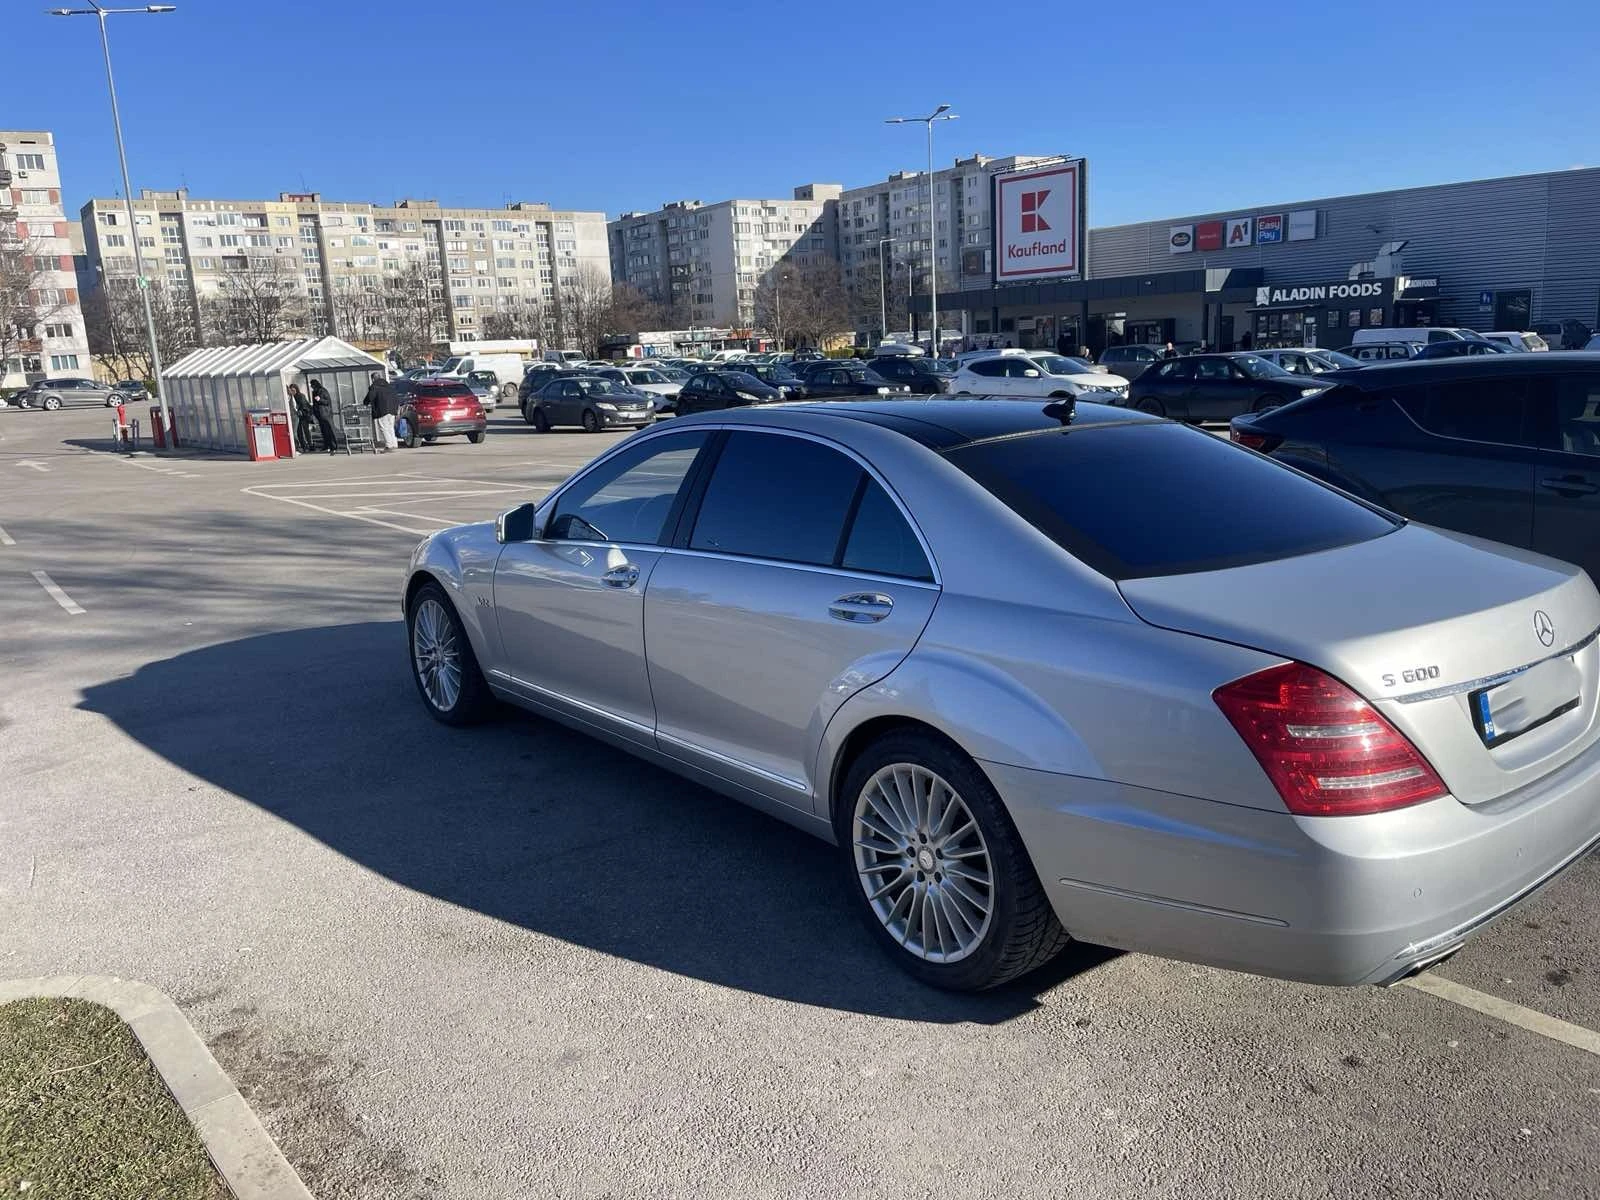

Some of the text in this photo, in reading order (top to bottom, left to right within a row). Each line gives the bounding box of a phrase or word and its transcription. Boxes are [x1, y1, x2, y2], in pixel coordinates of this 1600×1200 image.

[1229, 221, 1249, 244] A1
[1259, 220, 1281, 230] Easy
[1259, 230, 1276, 241] Pay
[1008, 238, 1066, 258] Kaufland
[1272, 282, 1383, 302] ALADIN FOODS
[1382, 665, 1440, 687] S 600
